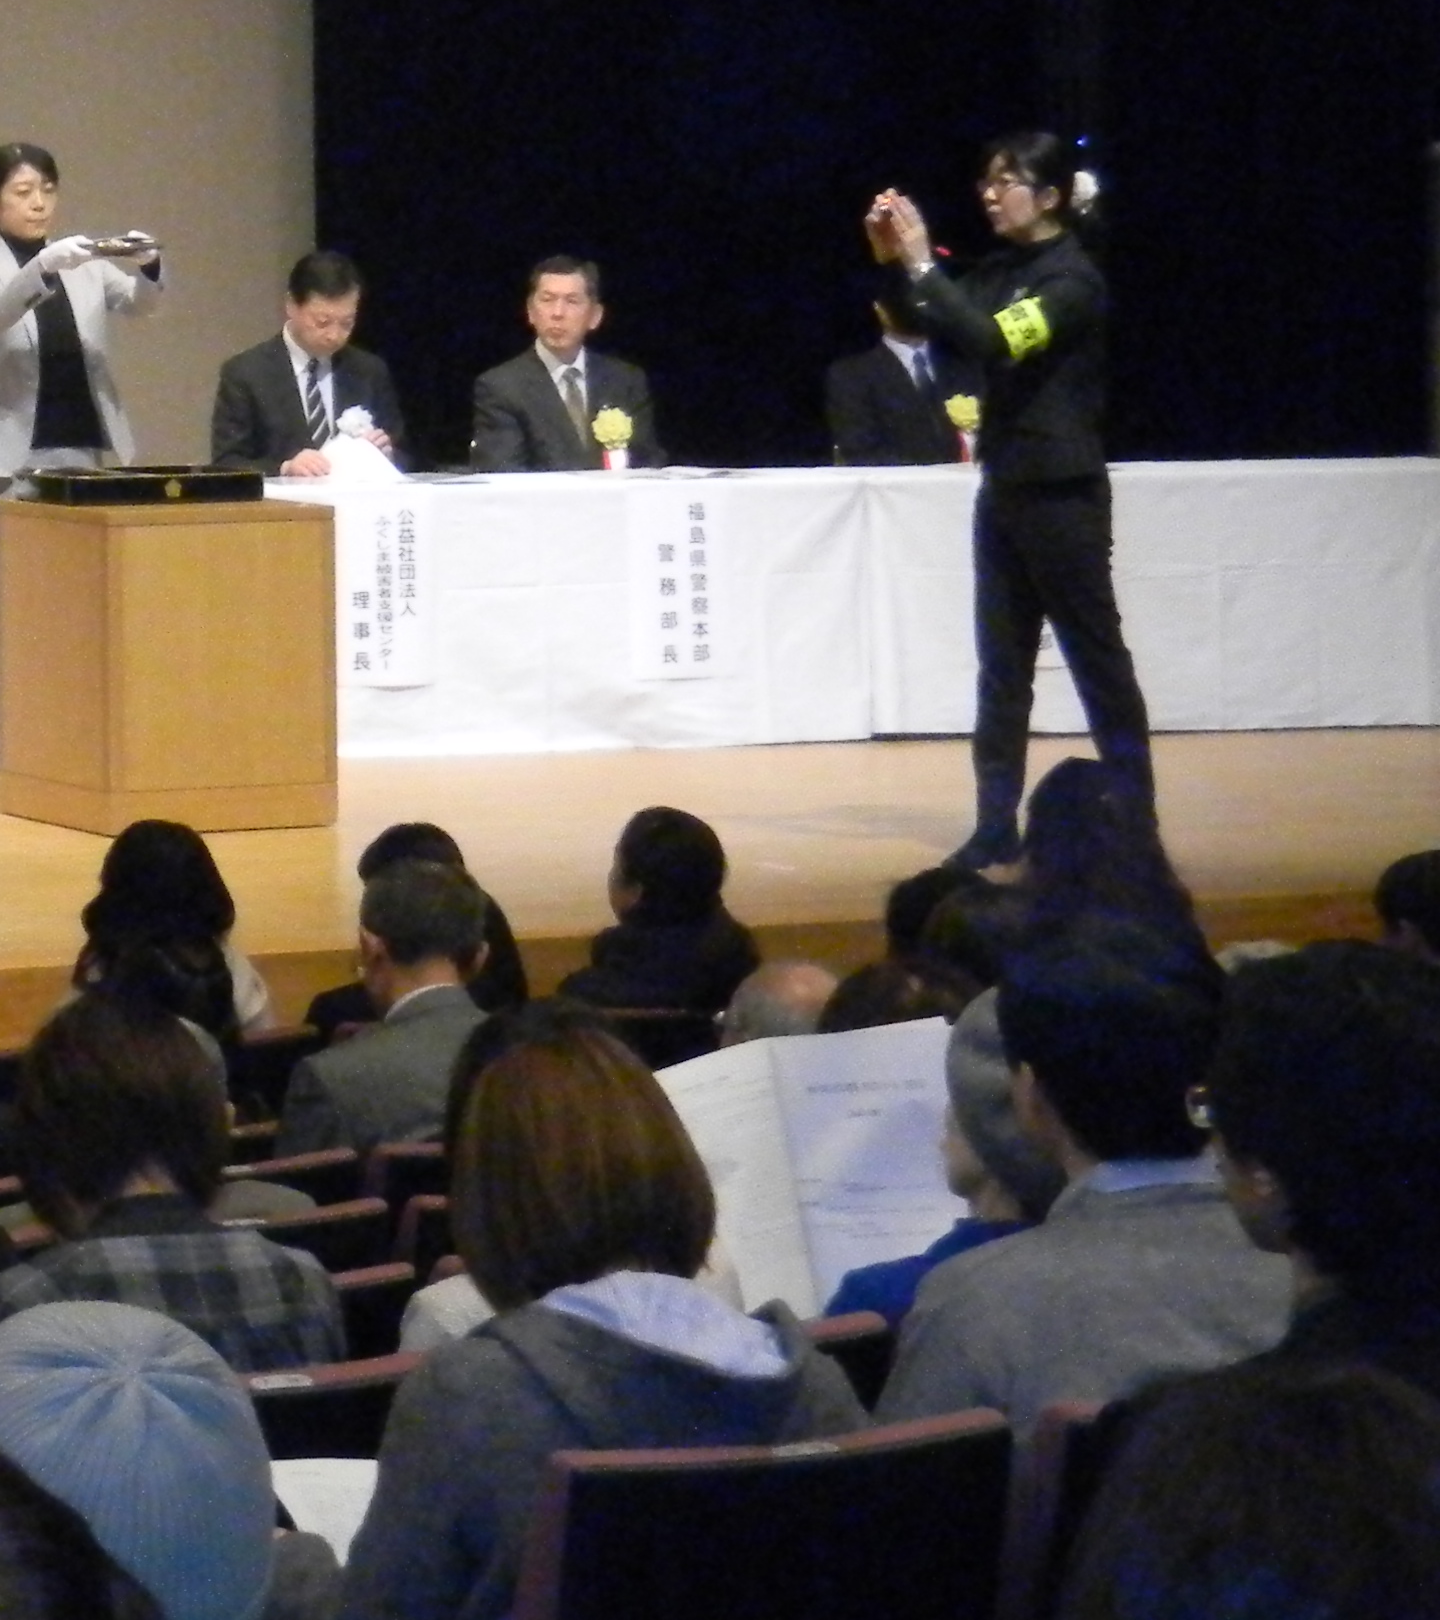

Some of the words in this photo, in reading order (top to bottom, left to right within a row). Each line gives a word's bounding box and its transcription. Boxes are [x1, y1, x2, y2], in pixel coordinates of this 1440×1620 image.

[397, 509, 417, 617] 公益社団法人
[688, 502, 710, 663] 福島県警察本部
[352, 591, 372, 672] 理事長
